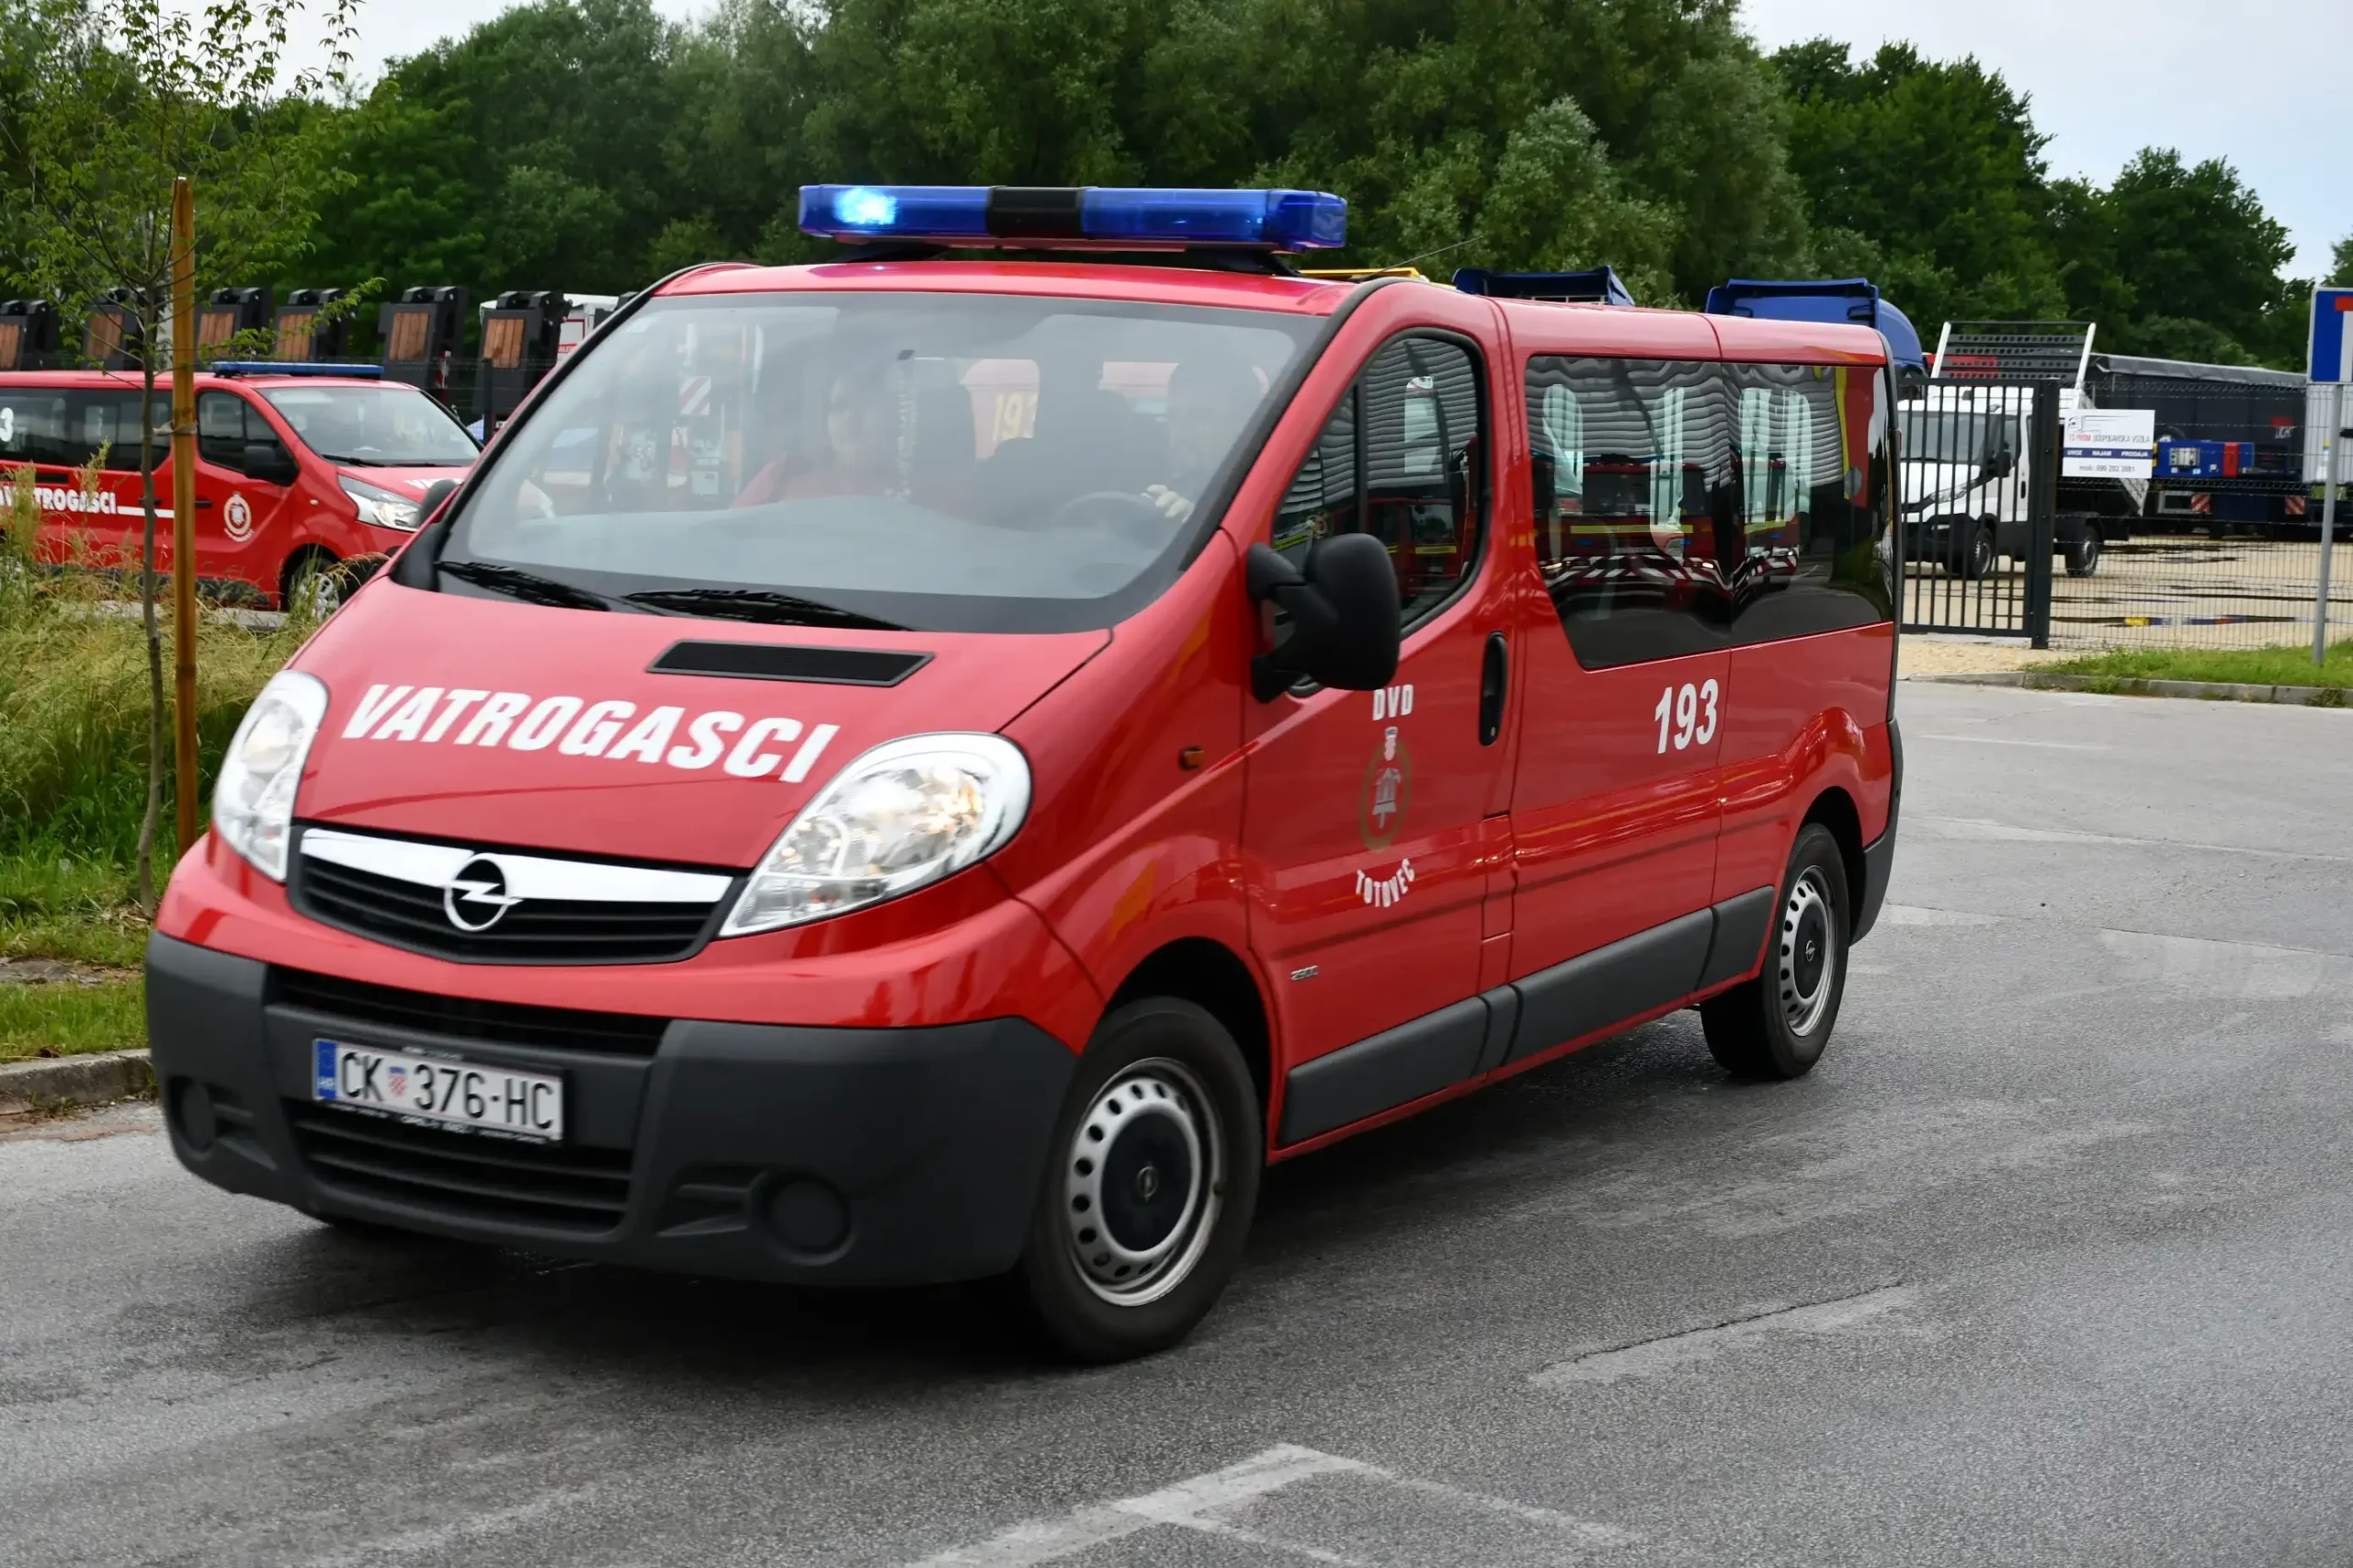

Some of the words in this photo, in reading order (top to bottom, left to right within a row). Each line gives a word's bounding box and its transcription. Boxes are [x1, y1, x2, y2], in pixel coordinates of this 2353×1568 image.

[3, 485, 117, 515] VTROGASCI
[1372, 684, 1415, 721] DVD
[1654, 678, 1719, 755] 193
[342, 684, 841, 783] VATROGASCI
[1356, 858, 1415, 908] TOTOVEC
[341, 1051, 383, 1102] CK
